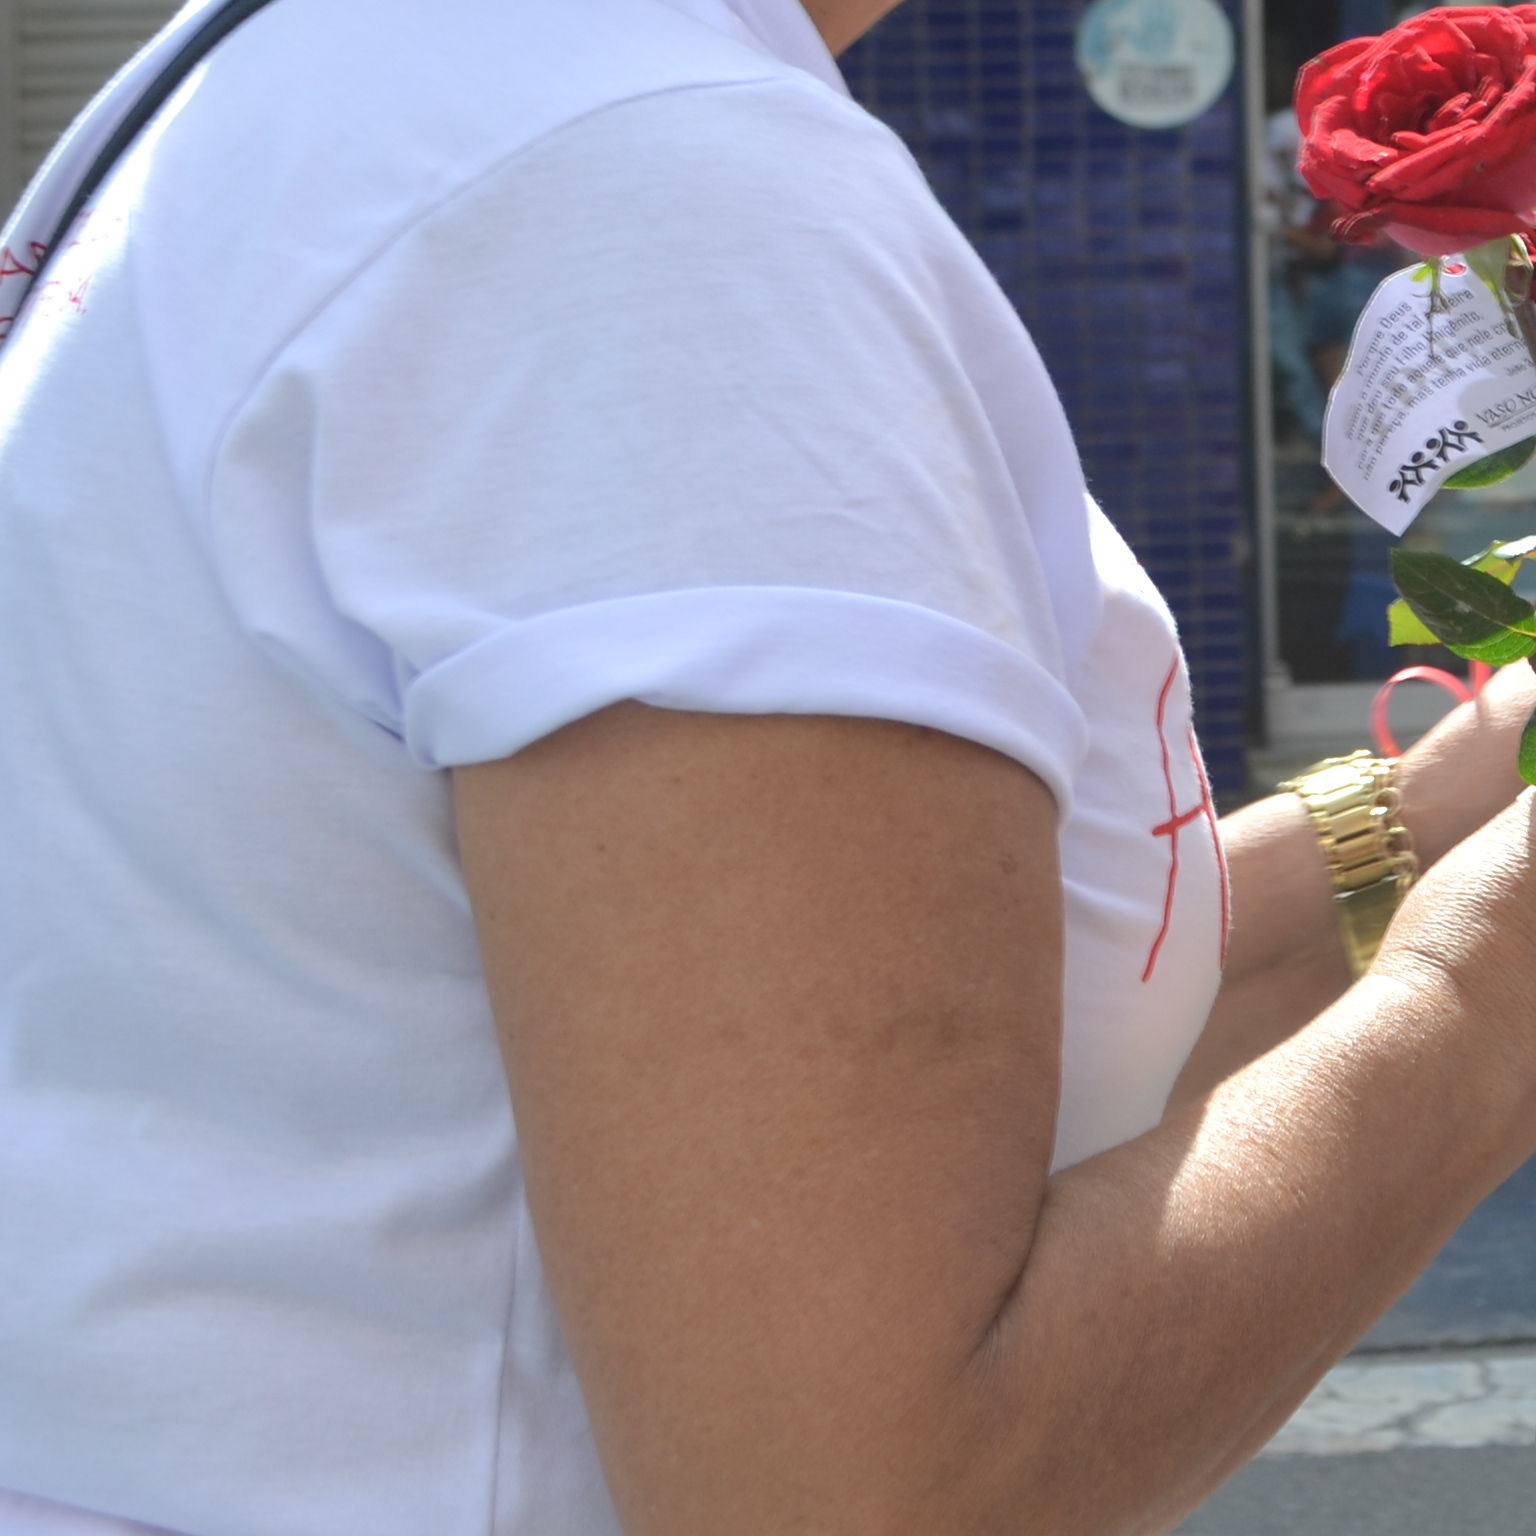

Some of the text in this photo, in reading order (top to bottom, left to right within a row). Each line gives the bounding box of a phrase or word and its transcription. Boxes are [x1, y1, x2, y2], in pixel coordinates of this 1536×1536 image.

[1378, 301, 1413, 329] Deus
[1364, 345, 1392, 388] mundo
[1390, 329, 1408, 346] de
[1404, 314, 1425, 333] tal
[1366, 389, 1383, 414] deu
[1380, 364, 1400, 389] seu
[1395, 341, 1427, 367] Filho
[1370, 411, 1386, 436] que
[1381, 382, 1408, 410] todo
[1444, 343, 1468, 359] que
[1467, 329, 1494, 347] nele
[1406, 385, 1434, 409] mas
[1429, 367, 1467, 387] tenha
[1464, 354, 1492, 373] vida
[1473, 396, 1517, 423] VASO
